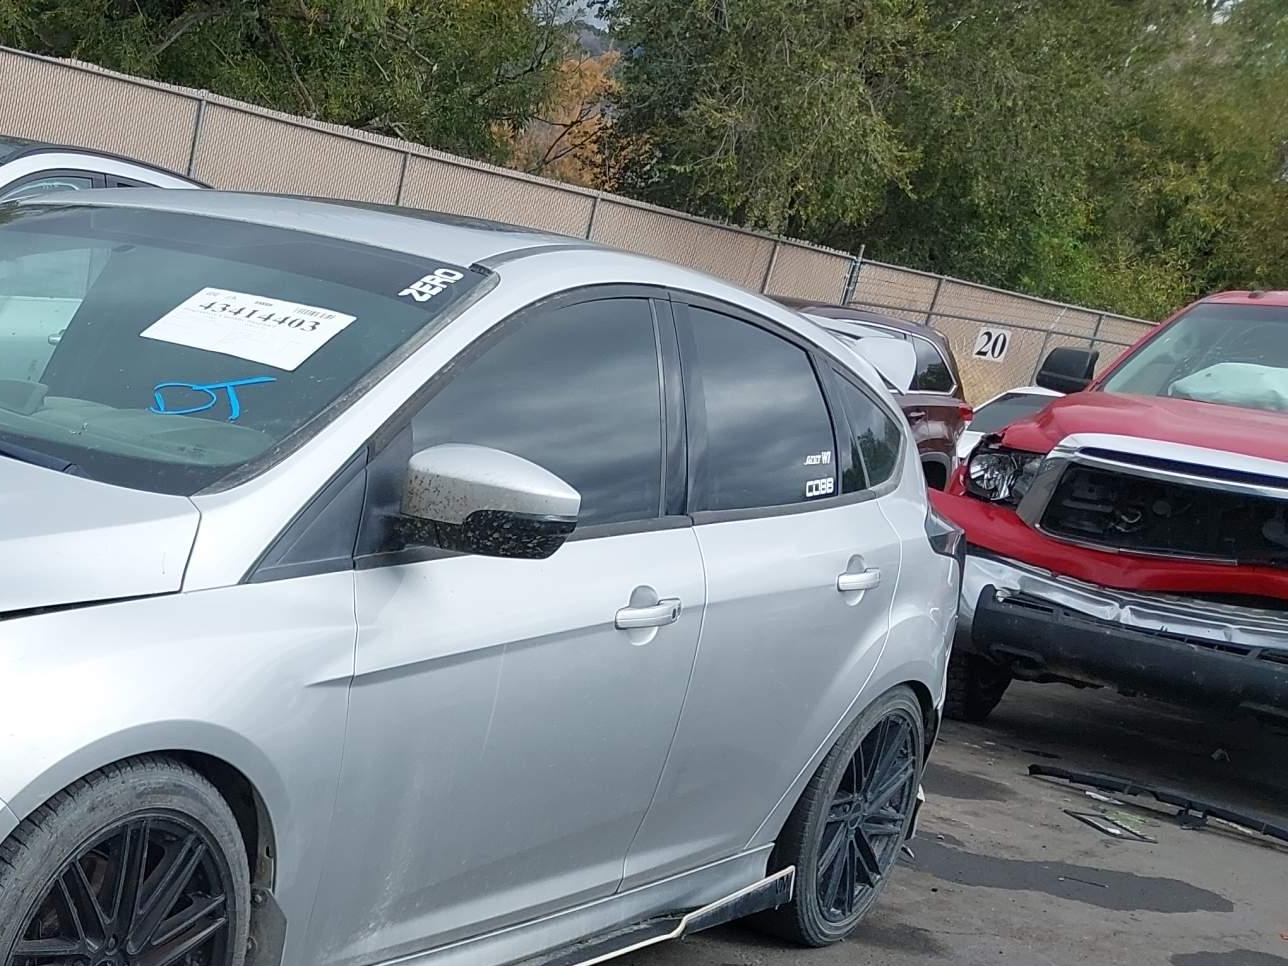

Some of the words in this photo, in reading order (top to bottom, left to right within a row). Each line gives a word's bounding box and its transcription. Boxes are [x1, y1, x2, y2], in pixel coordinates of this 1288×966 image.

[398, 268, 464, 302] ZERO
[199, 301, 321, 332] 43414403
[975, 331, 1007, 359] 20
[805, 477, 834, 497] COBB
